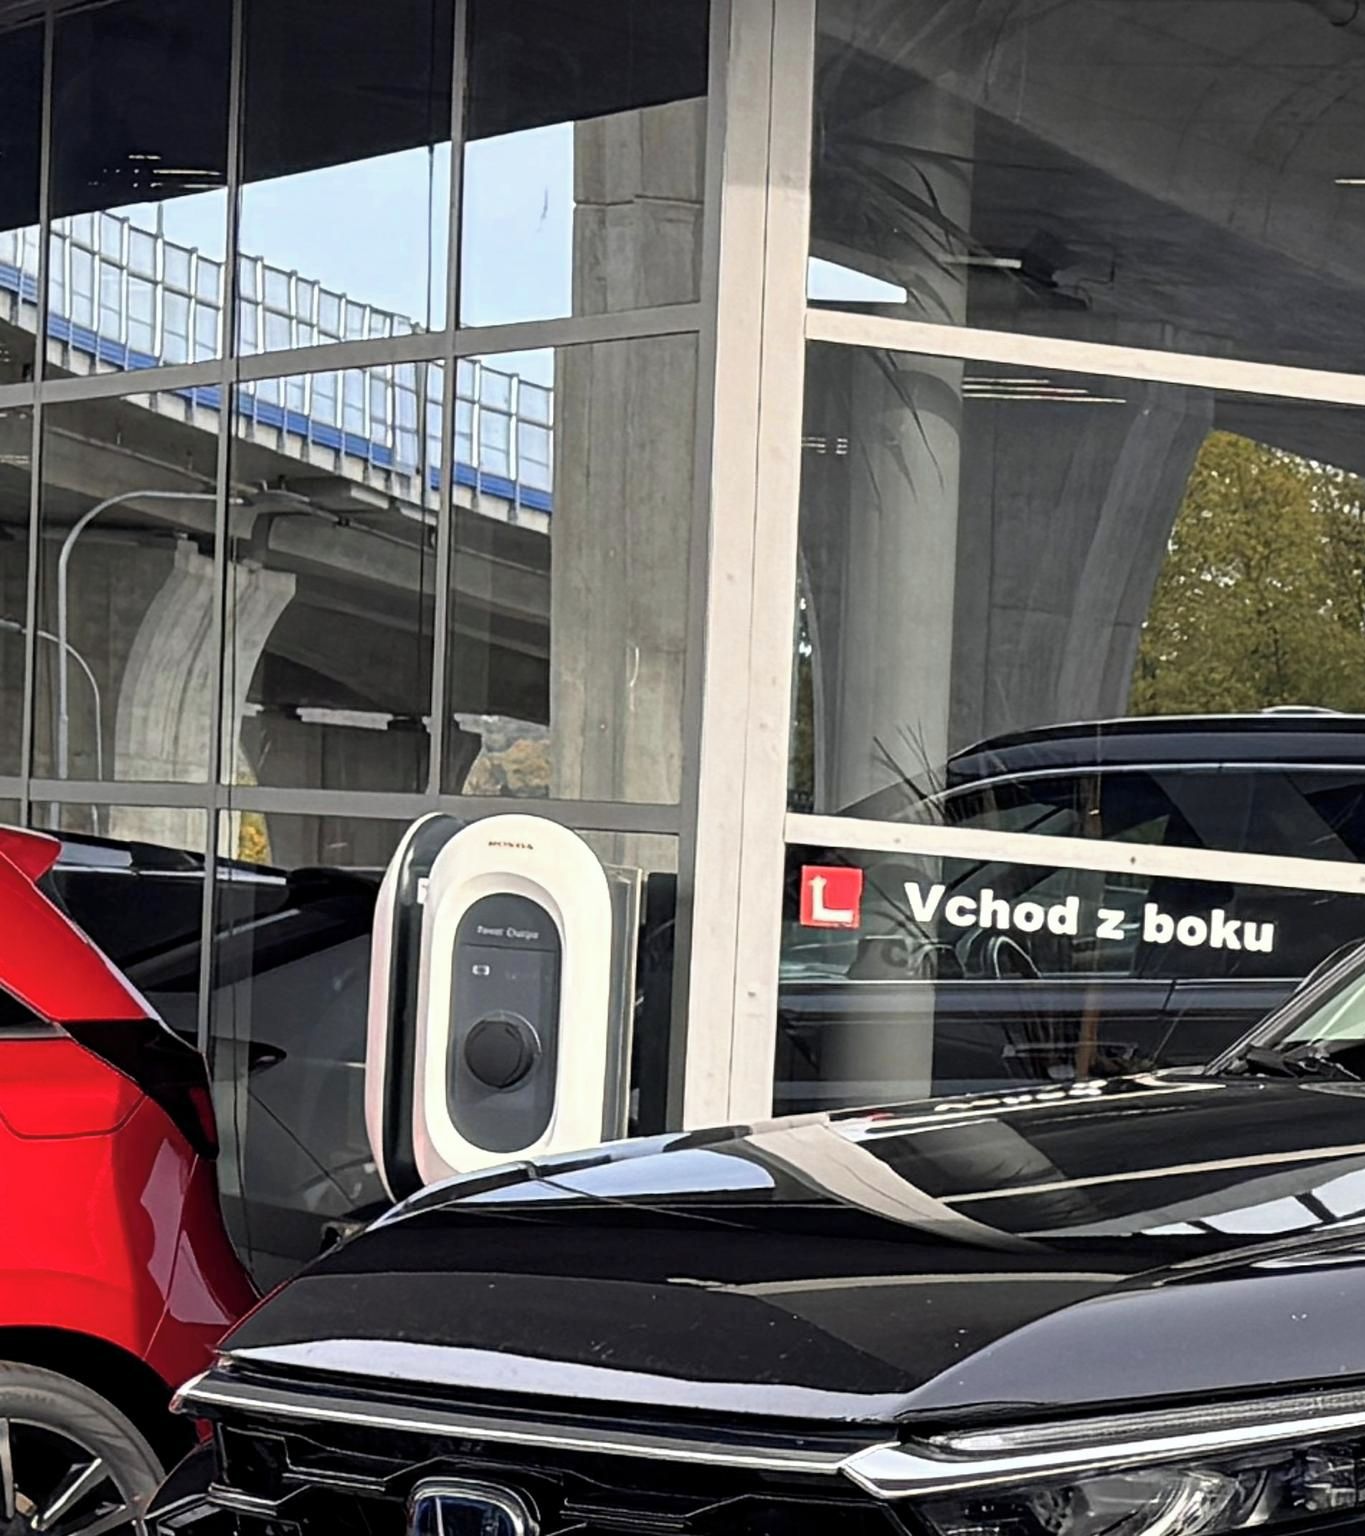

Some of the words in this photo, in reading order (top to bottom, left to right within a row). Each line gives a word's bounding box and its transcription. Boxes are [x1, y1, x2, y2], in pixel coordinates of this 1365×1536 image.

[904, 882, 1080, 936] Vchod
[1096, 907, 1126, 940] z
[1142, 903, 1276, 953] boku
